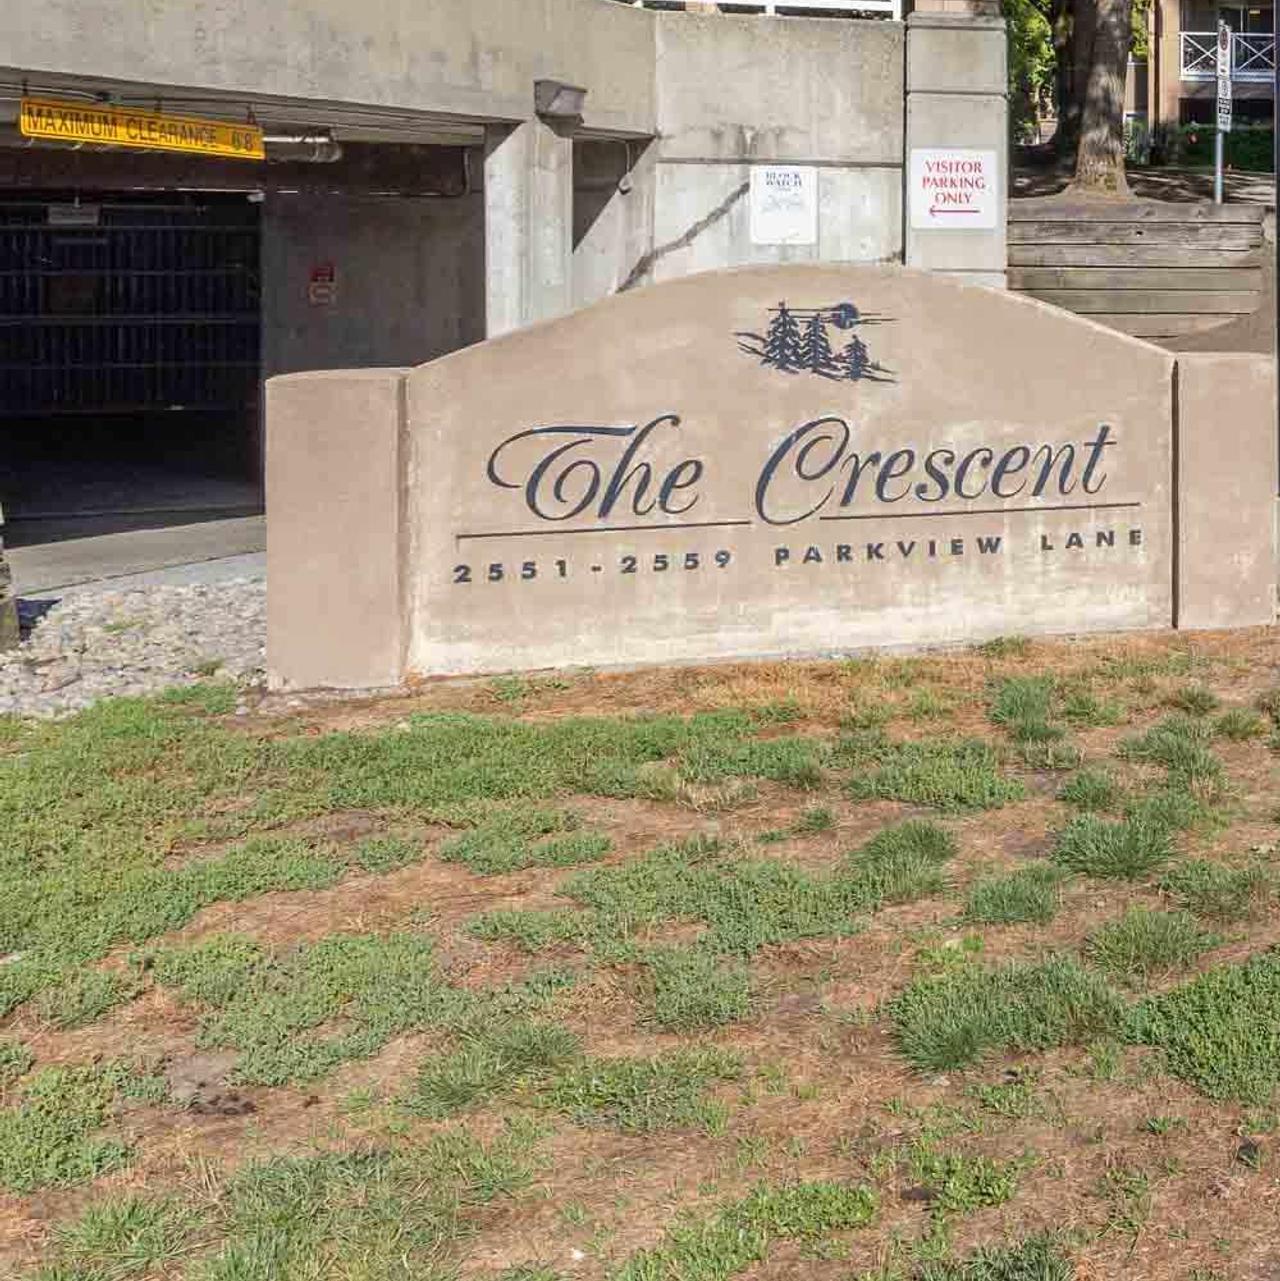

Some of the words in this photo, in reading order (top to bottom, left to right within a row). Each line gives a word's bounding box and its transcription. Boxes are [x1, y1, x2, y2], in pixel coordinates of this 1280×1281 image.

[26, 106, 118, 138] MAXIMUM
[126, 117, 217, 149] CLEARANCE
[925, 160, 983, 174] VISITOR
[922, 176, 986, 190] PARKING
[934, 192, 973, 205] ONLY
[486, 413, 704, 522] The
[754, 415, 1118, 526] Crescent
[774, 536, 1003, 567] PARKVIEW
[1040, 528, 1144, 552] LANE
